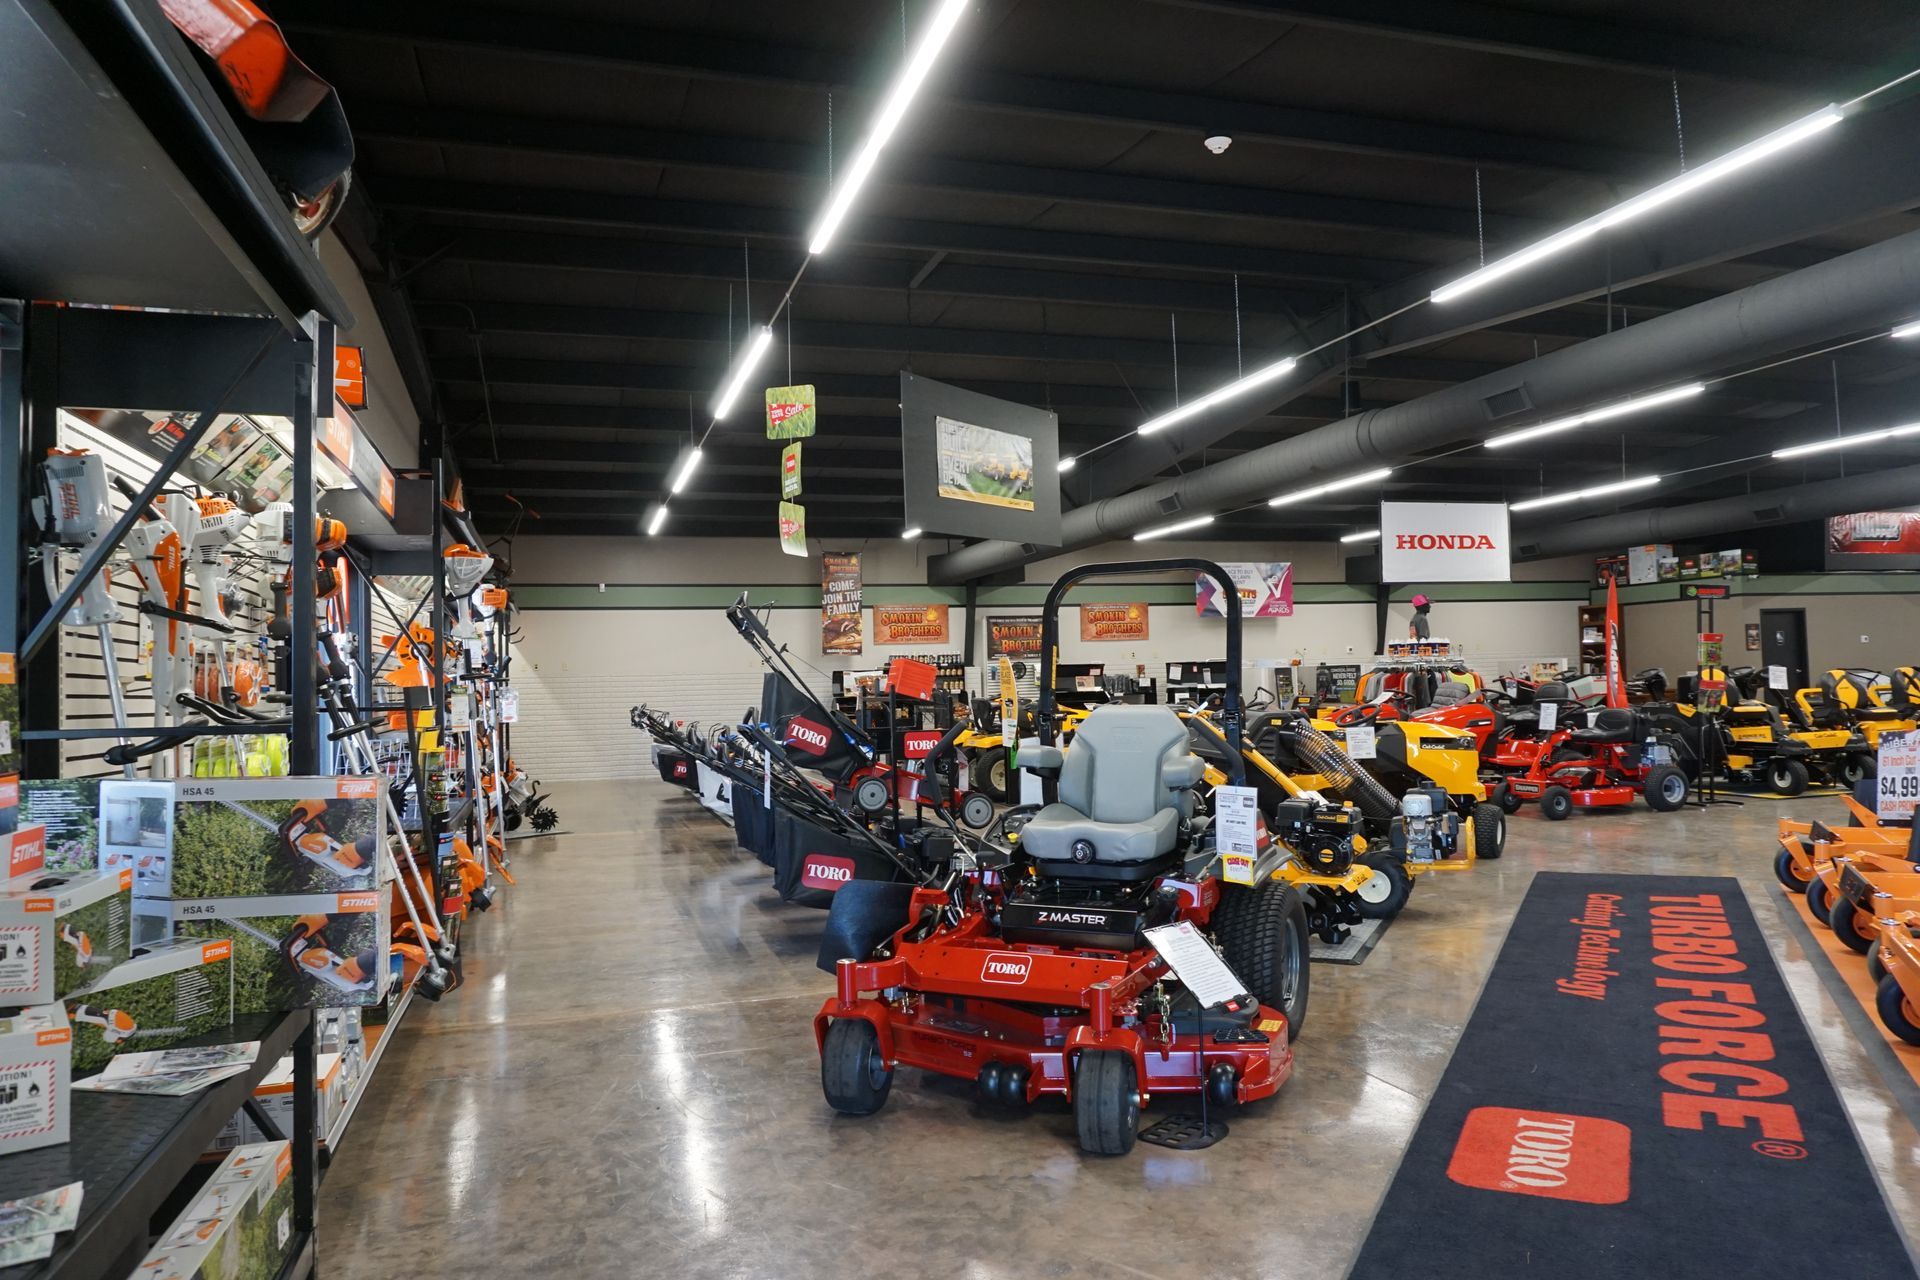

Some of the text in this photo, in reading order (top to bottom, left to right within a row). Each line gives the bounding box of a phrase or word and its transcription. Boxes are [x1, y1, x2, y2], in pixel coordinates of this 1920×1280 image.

[784, 403, 804, 418] Sale
[1395, 534, 1496, 550] HONDA
[829, 580, 855, 592] COME
[822, 590, 862, 605] JOIN THE
[827, 602, 860, 616] FAMILY
[880, 612, 923, 625] SMOKIN
[1088, 610, 1126, 623] SMOKIN
[889, 624, 942, 638] BROTHERS
[992, 625, 1034, 640] SMOKIN
[1095, 623, 1144, 636] BROTHERS
[1001, 638, 1042, 653] BROTHE
[791, 724, 826, 747] TORO
[907, 740, 938, 751] TORO
[182, 787, 215, 797] HSA 45
[341, 784, 375, 794] STIHL
[12, 843, 43, 865] STIHL
[808, 864, 851, 882] TORO
[342, 898, 376, 907] STIHL
[183, 906, 215, 915] HSA 45
[1037, 912, 1105, 925] Z MASTER
[204, 947, 229, 958] STIHL
[1556, 893, 1626, 1000] Cutting Technology
[988, 962, 1026, 975] TORO
[1649, 894, 1805, 1142] TURBO FORCE
[1504, 1116, 1576, 1188] TORO
